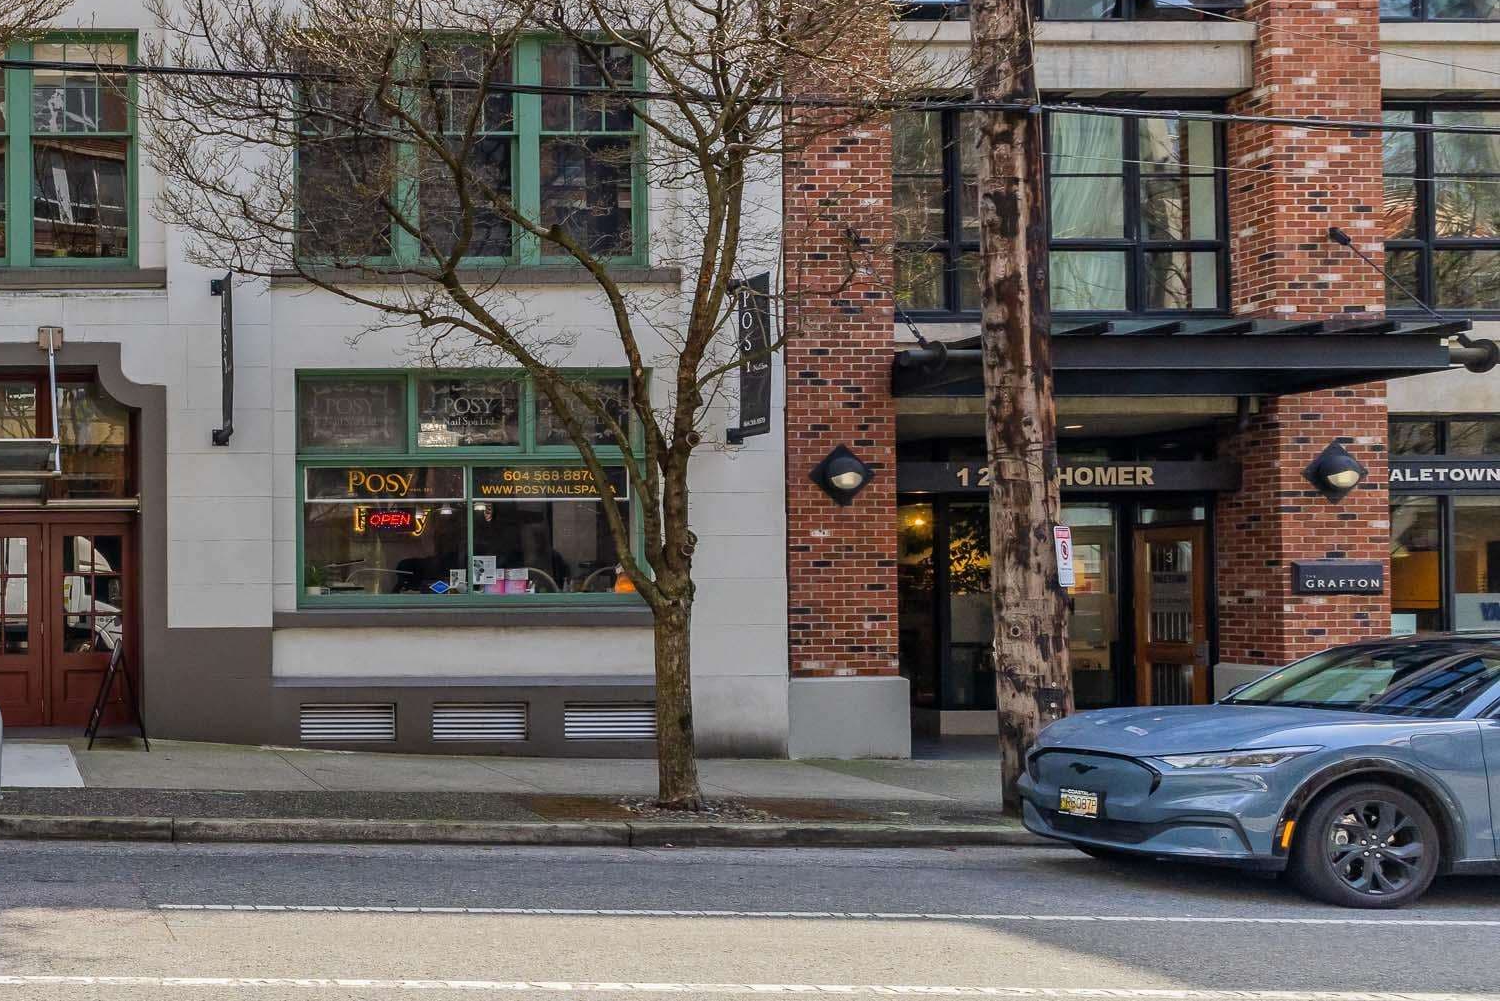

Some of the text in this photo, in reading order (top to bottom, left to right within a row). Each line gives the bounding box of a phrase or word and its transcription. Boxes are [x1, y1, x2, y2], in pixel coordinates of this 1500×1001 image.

[443, 397, 494, 414] POSY
[443, 416, 461, 426] Nail
[462, 416, 479, 428] Spa
[503, 470, 530, 481] 604
[1056, 466, 1155, 486] HOMER
[1388, 468, 1500, 482] ALETOWN
[481, 485, 617, 495] WWW.POSYNAILSPA.A
[369, 513, 412, 526] OPEN
[1305, 579, 1380, 588] GRAFTON
